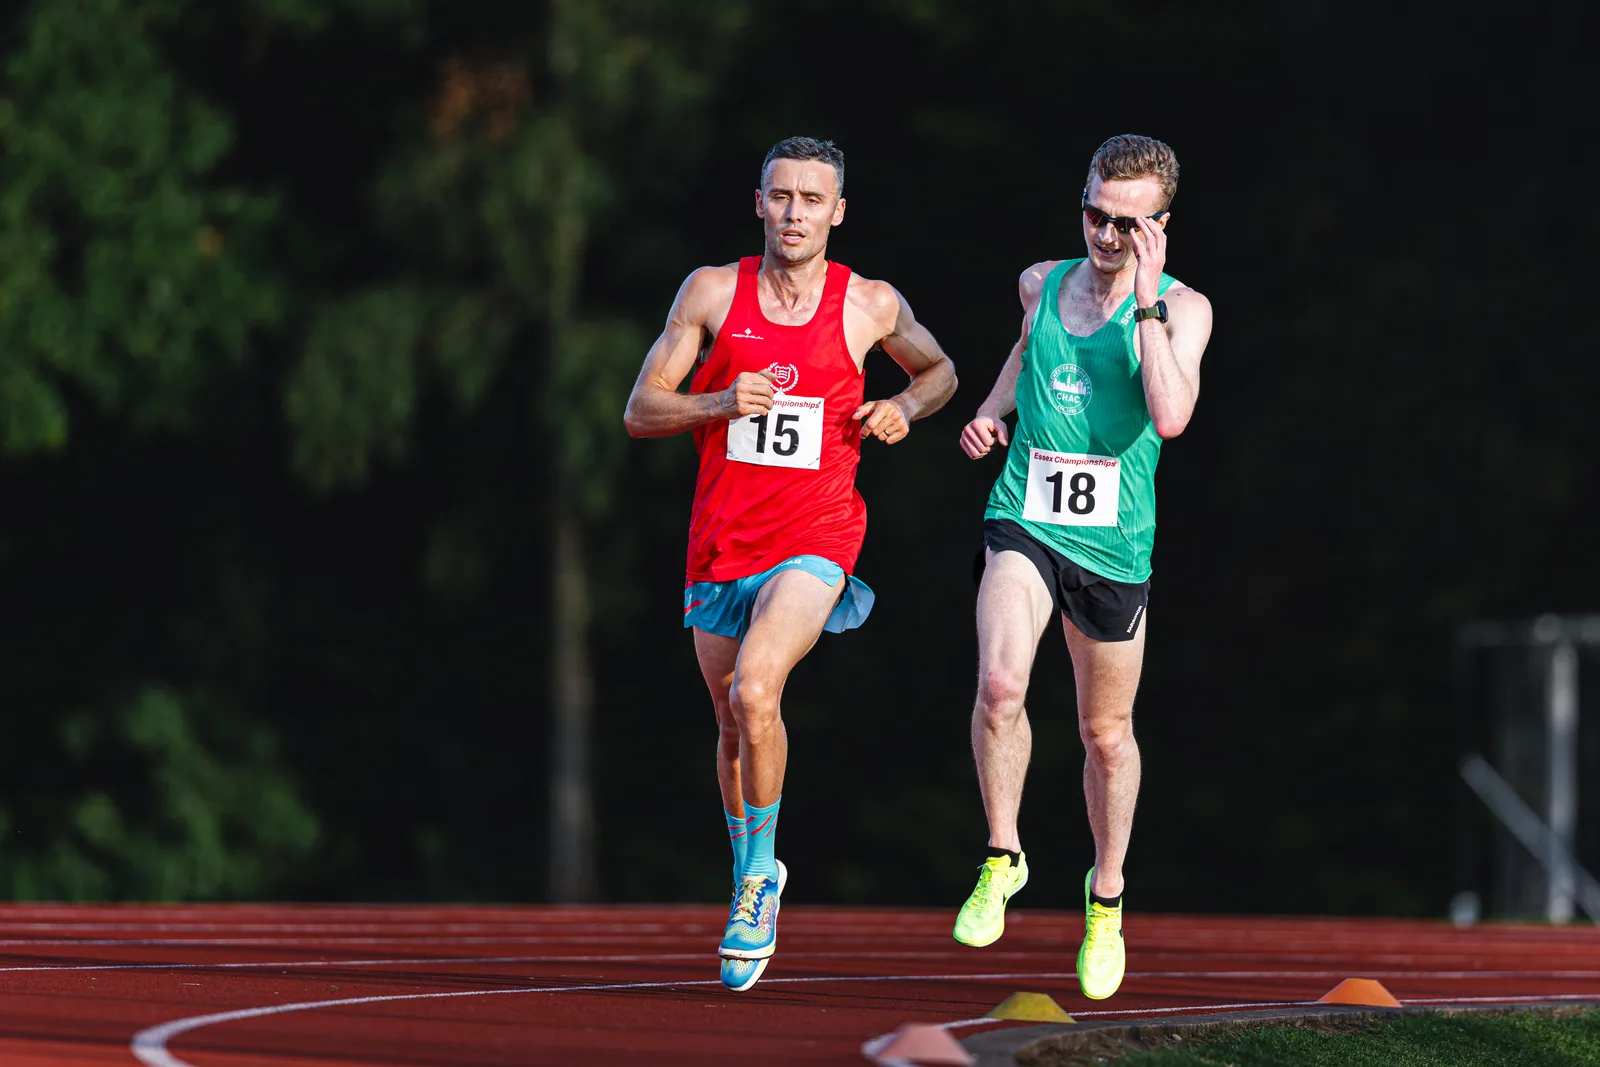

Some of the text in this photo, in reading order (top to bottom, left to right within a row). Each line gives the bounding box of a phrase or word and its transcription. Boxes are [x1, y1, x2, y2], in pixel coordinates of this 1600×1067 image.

[771, 399, 820, 409] ampionships
[1056, 392, 1081, 404] CHAC
[749, 413, 800, 457] 15
[1033, 452, 1117, 468] Essex Championships
[1045, 471, 1096, 515] 18
